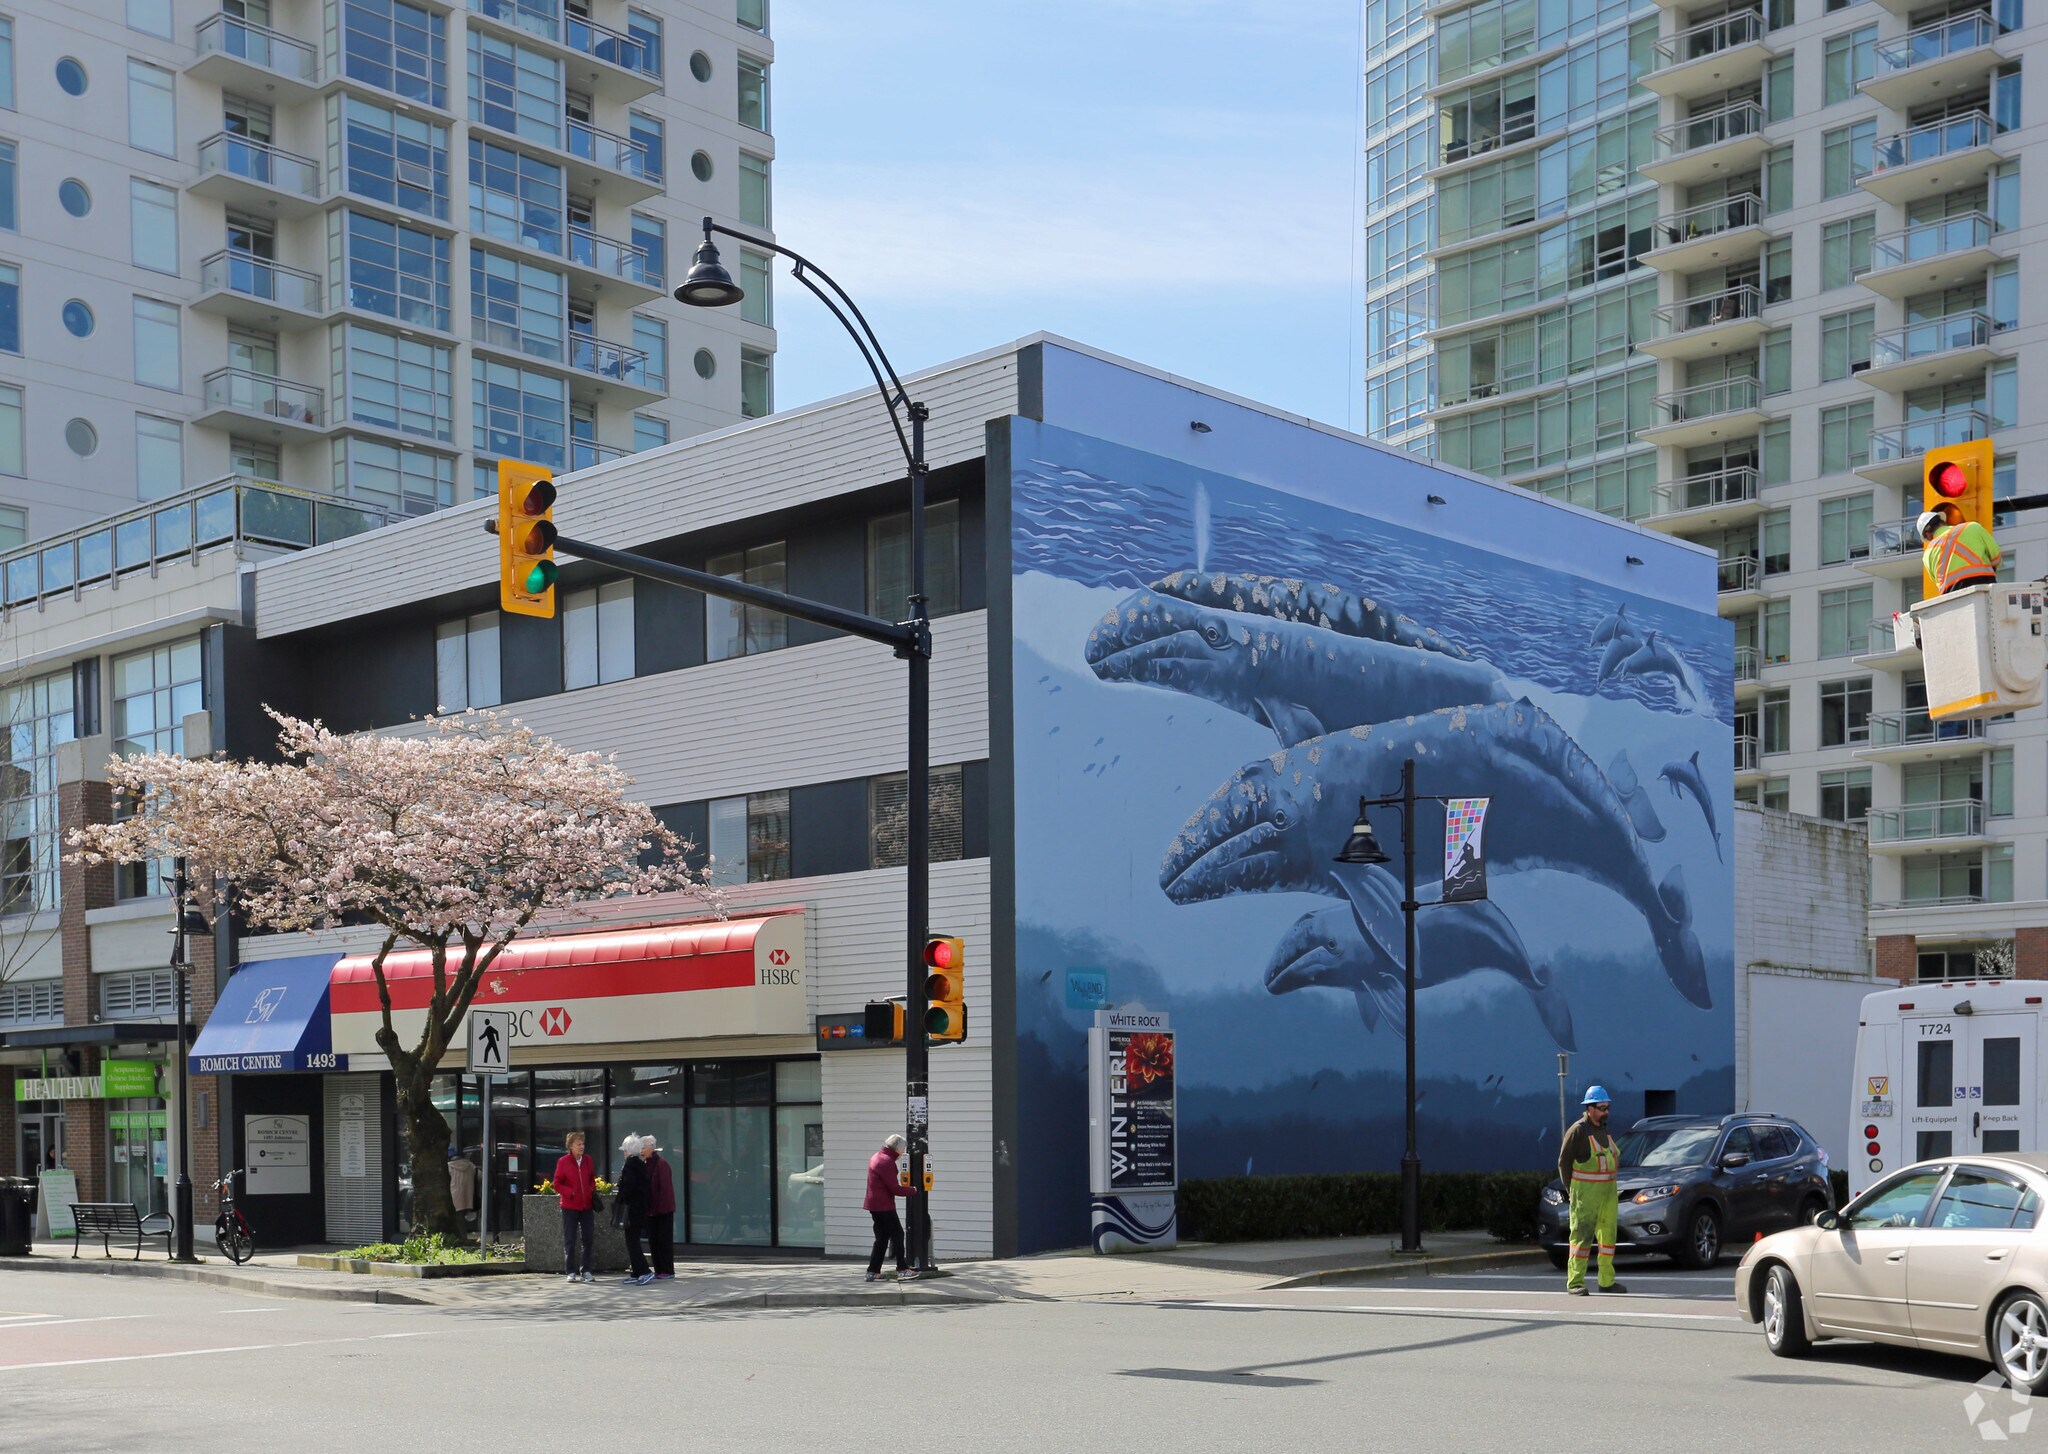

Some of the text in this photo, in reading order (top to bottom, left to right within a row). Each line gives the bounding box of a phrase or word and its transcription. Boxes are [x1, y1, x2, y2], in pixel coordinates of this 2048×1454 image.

[760, 968, 800, 986] HSBC
[508, 1009, 534, 1038] BC
[1109, 1012, 1161, 1027] WHITE ROCK
[1919, 1023, 1952, 1035] T724
[200, 1054, 282, 1072] ROMICH CENTRE
[306, 1053, 337, 1069] 1493
[107, 1074, 152, 1082] Chinese Medicine
[112, 1066, 146, 1075] Acupuncture
[23, 1077, 88, 1100] HEALTHY
[113, 1083, 146, 1093] Supplements
[1110, 1050, 1128, 1179] WINTER!
[1911, 1116, 1958, 1124] Lift-Equipped
[1983, 1115, 2001, 1123] Keep
